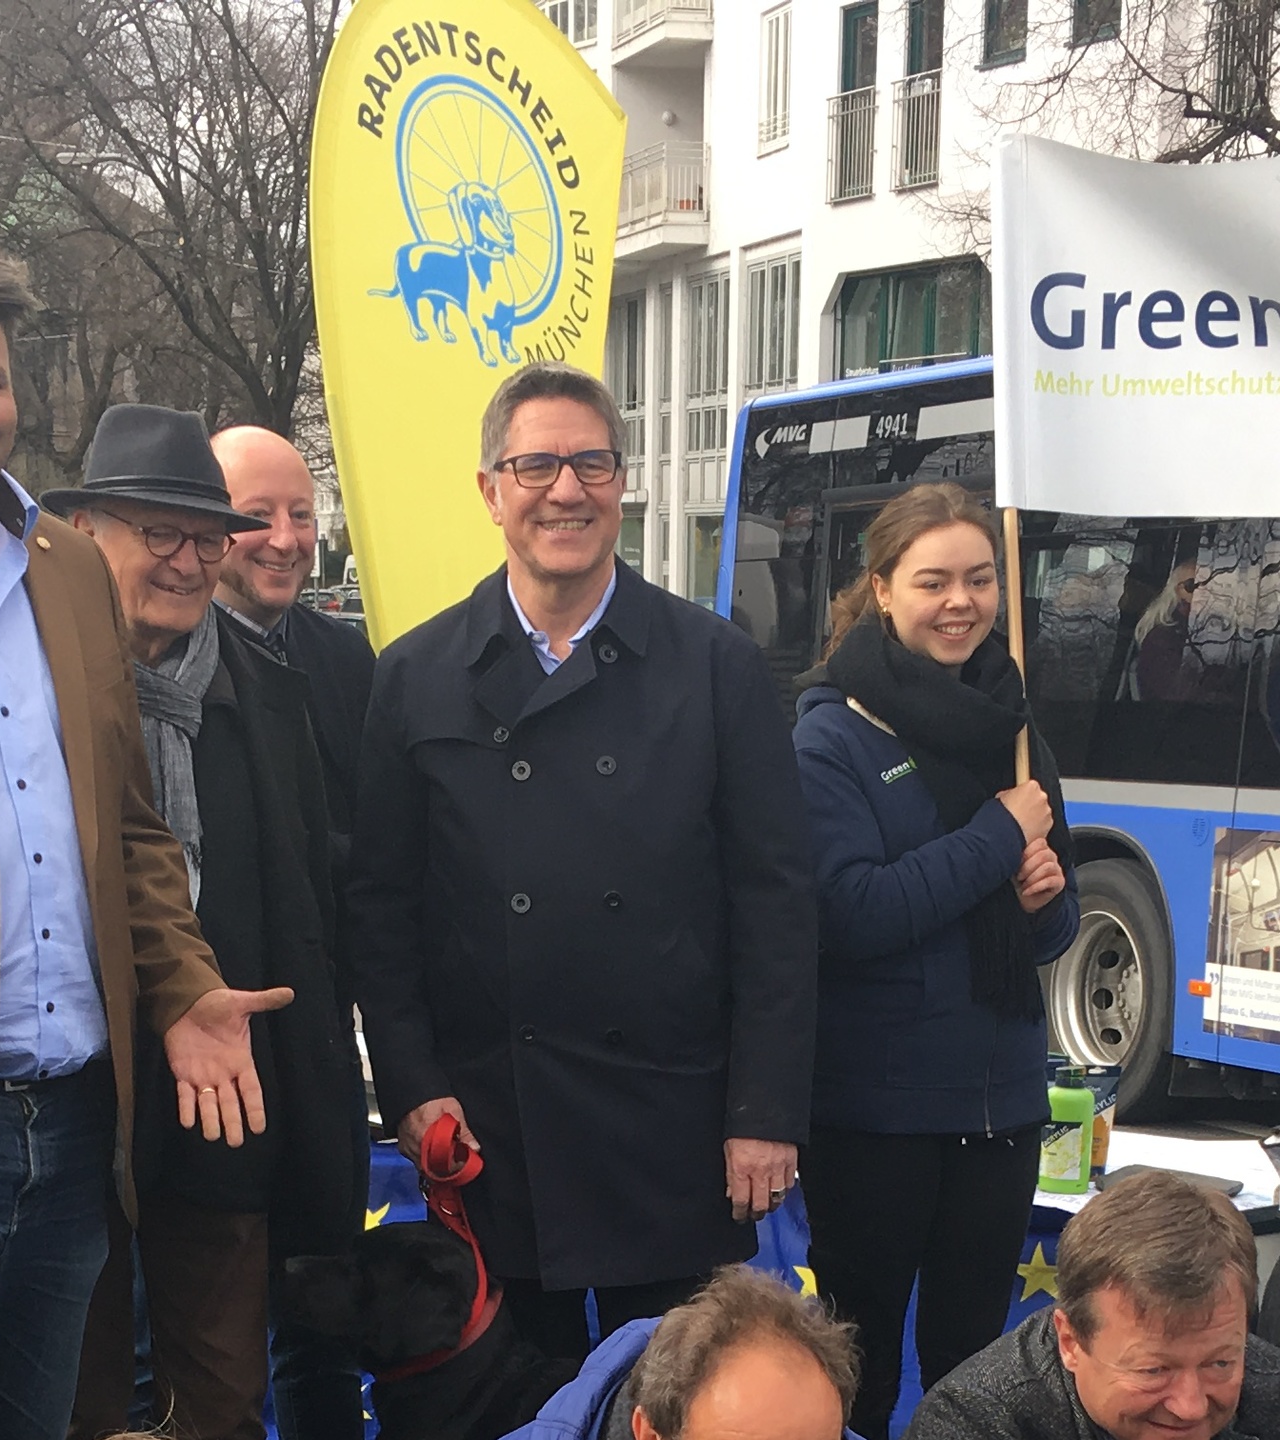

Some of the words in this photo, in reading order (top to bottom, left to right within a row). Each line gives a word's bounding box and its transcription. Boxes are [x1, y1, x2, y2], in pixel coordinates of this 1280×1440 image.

[357, 20, 581, 190] RADENTSCHEID
[524, 210, 594, 367] MÜNCHEN
[1034, 368, 1095, 397] Mehr
[770, 423, 808, 445] MVG
[875, 412, 909, 439] 4941
[880, 762, 911, 781] Green
